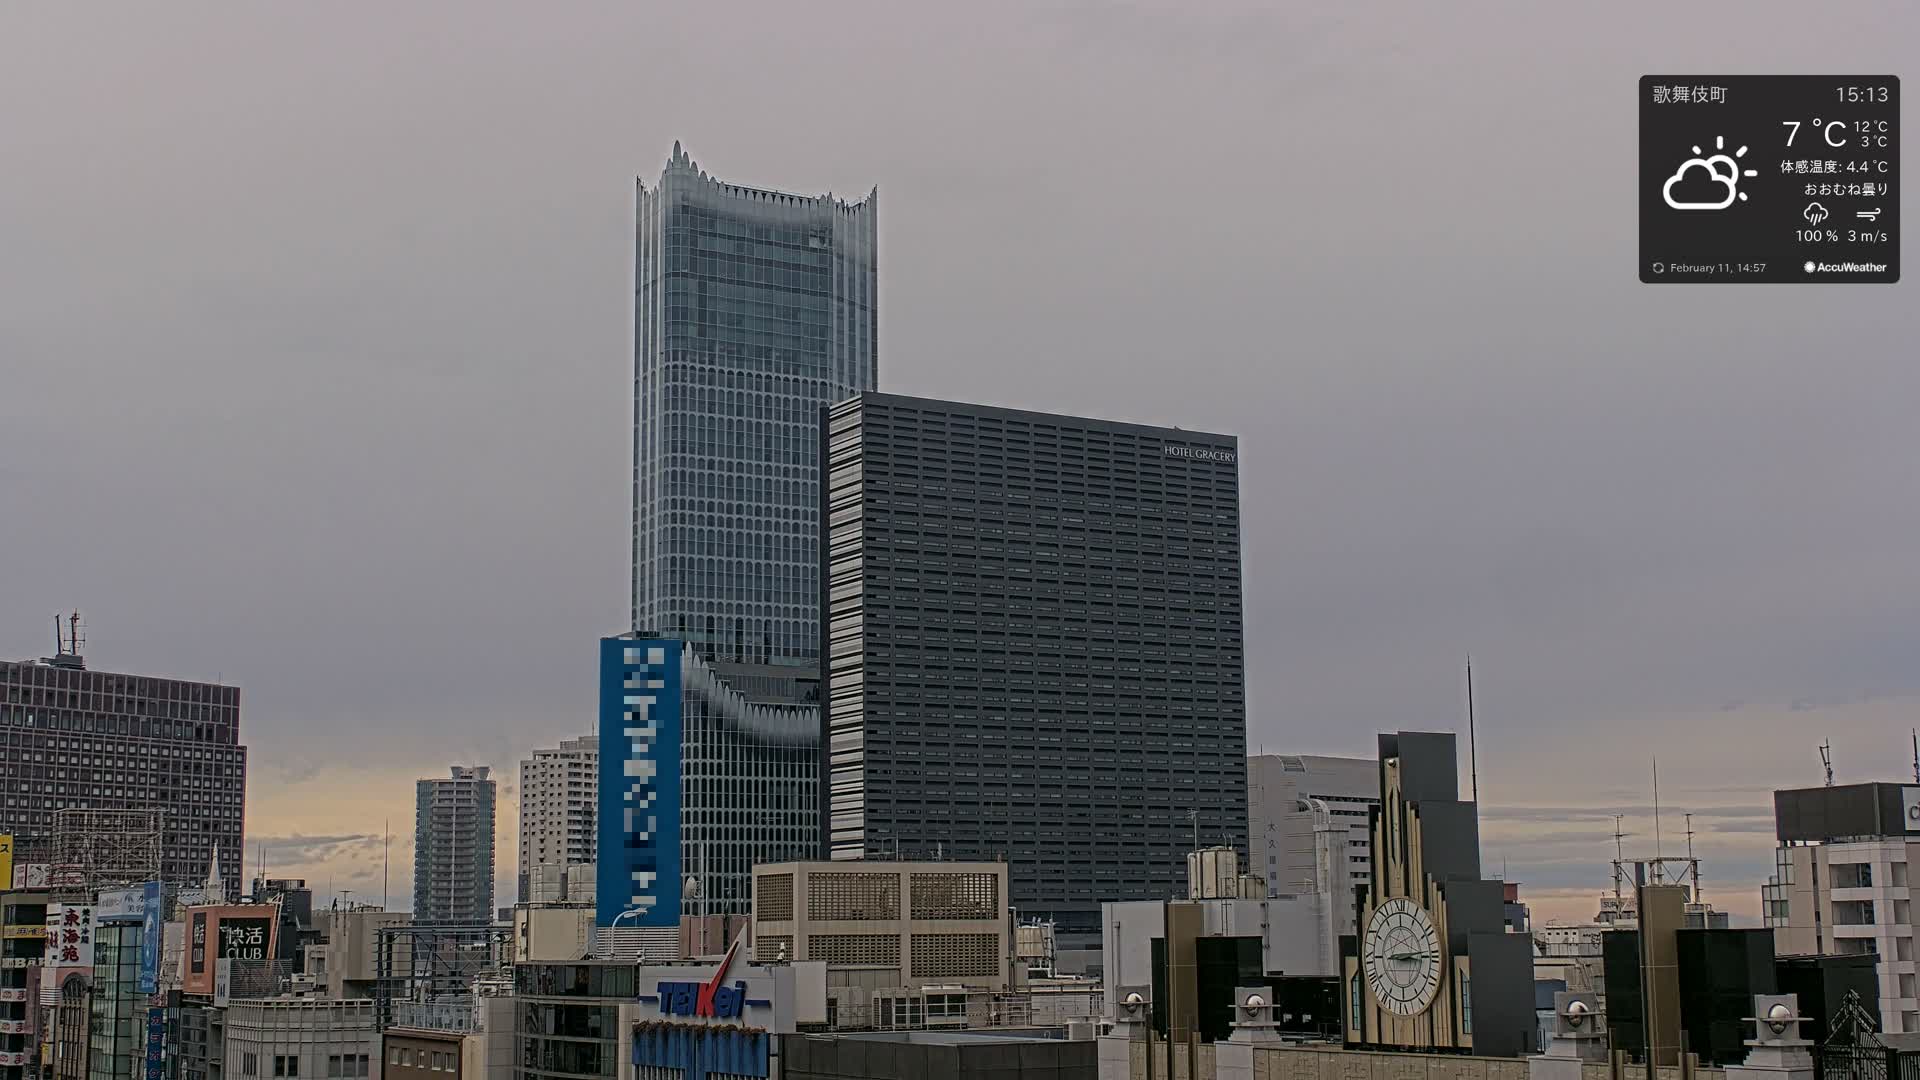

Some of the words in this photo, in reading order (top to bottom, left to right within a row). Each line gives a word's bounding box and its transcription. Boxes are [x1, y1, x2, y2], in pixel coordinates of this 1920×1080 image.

[1164, 446, 1194, 457] HOTEL
[1195, 449, 1236, 462] GRACERY
[60, 907, 80, 963] 東海苑
[227, 926, 263, 945] 快活
[227, 947, 262, 960] CLUB
